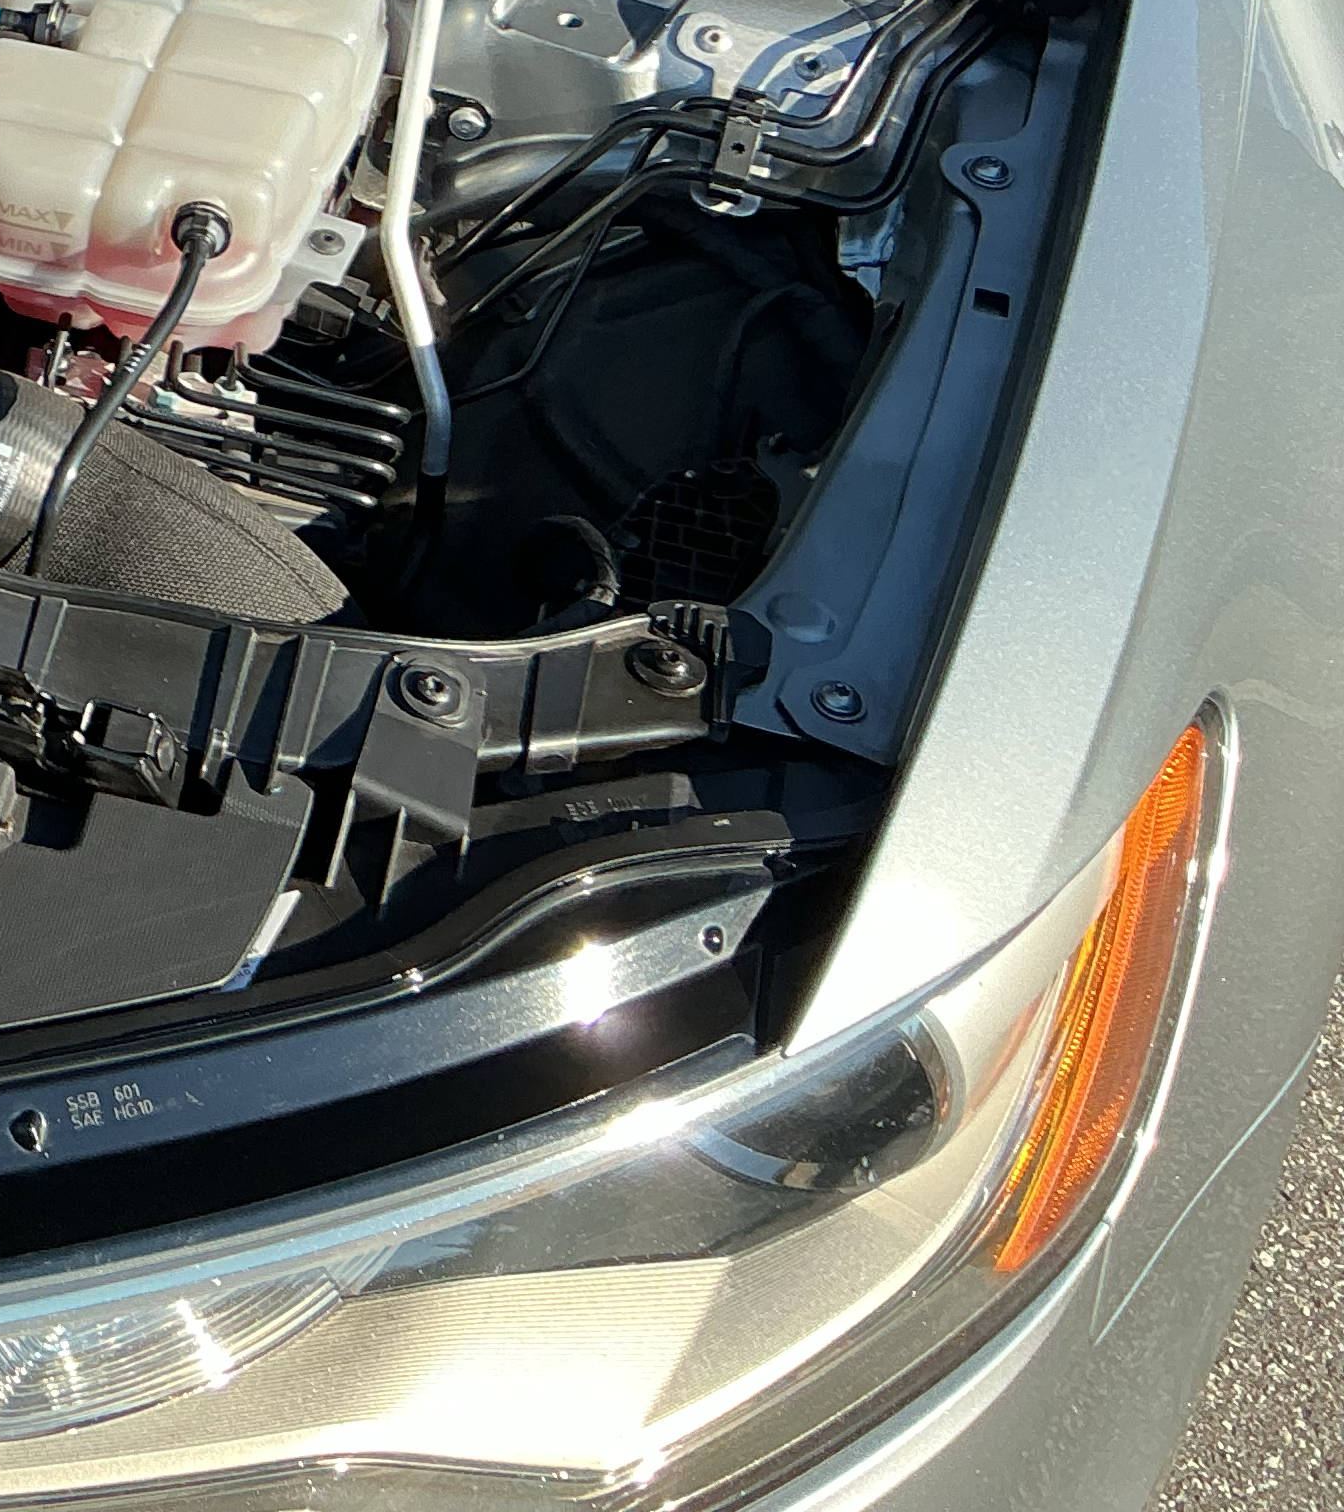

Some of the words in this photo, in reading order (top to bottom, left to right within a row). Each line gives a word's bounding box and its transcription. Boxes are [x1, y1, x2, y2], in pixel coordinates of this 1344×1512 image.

[65, 1090, 101, 1113] SSB
[113, 1082, 141, 1102] 601
[70, 1110, 105, 1130] SAE
